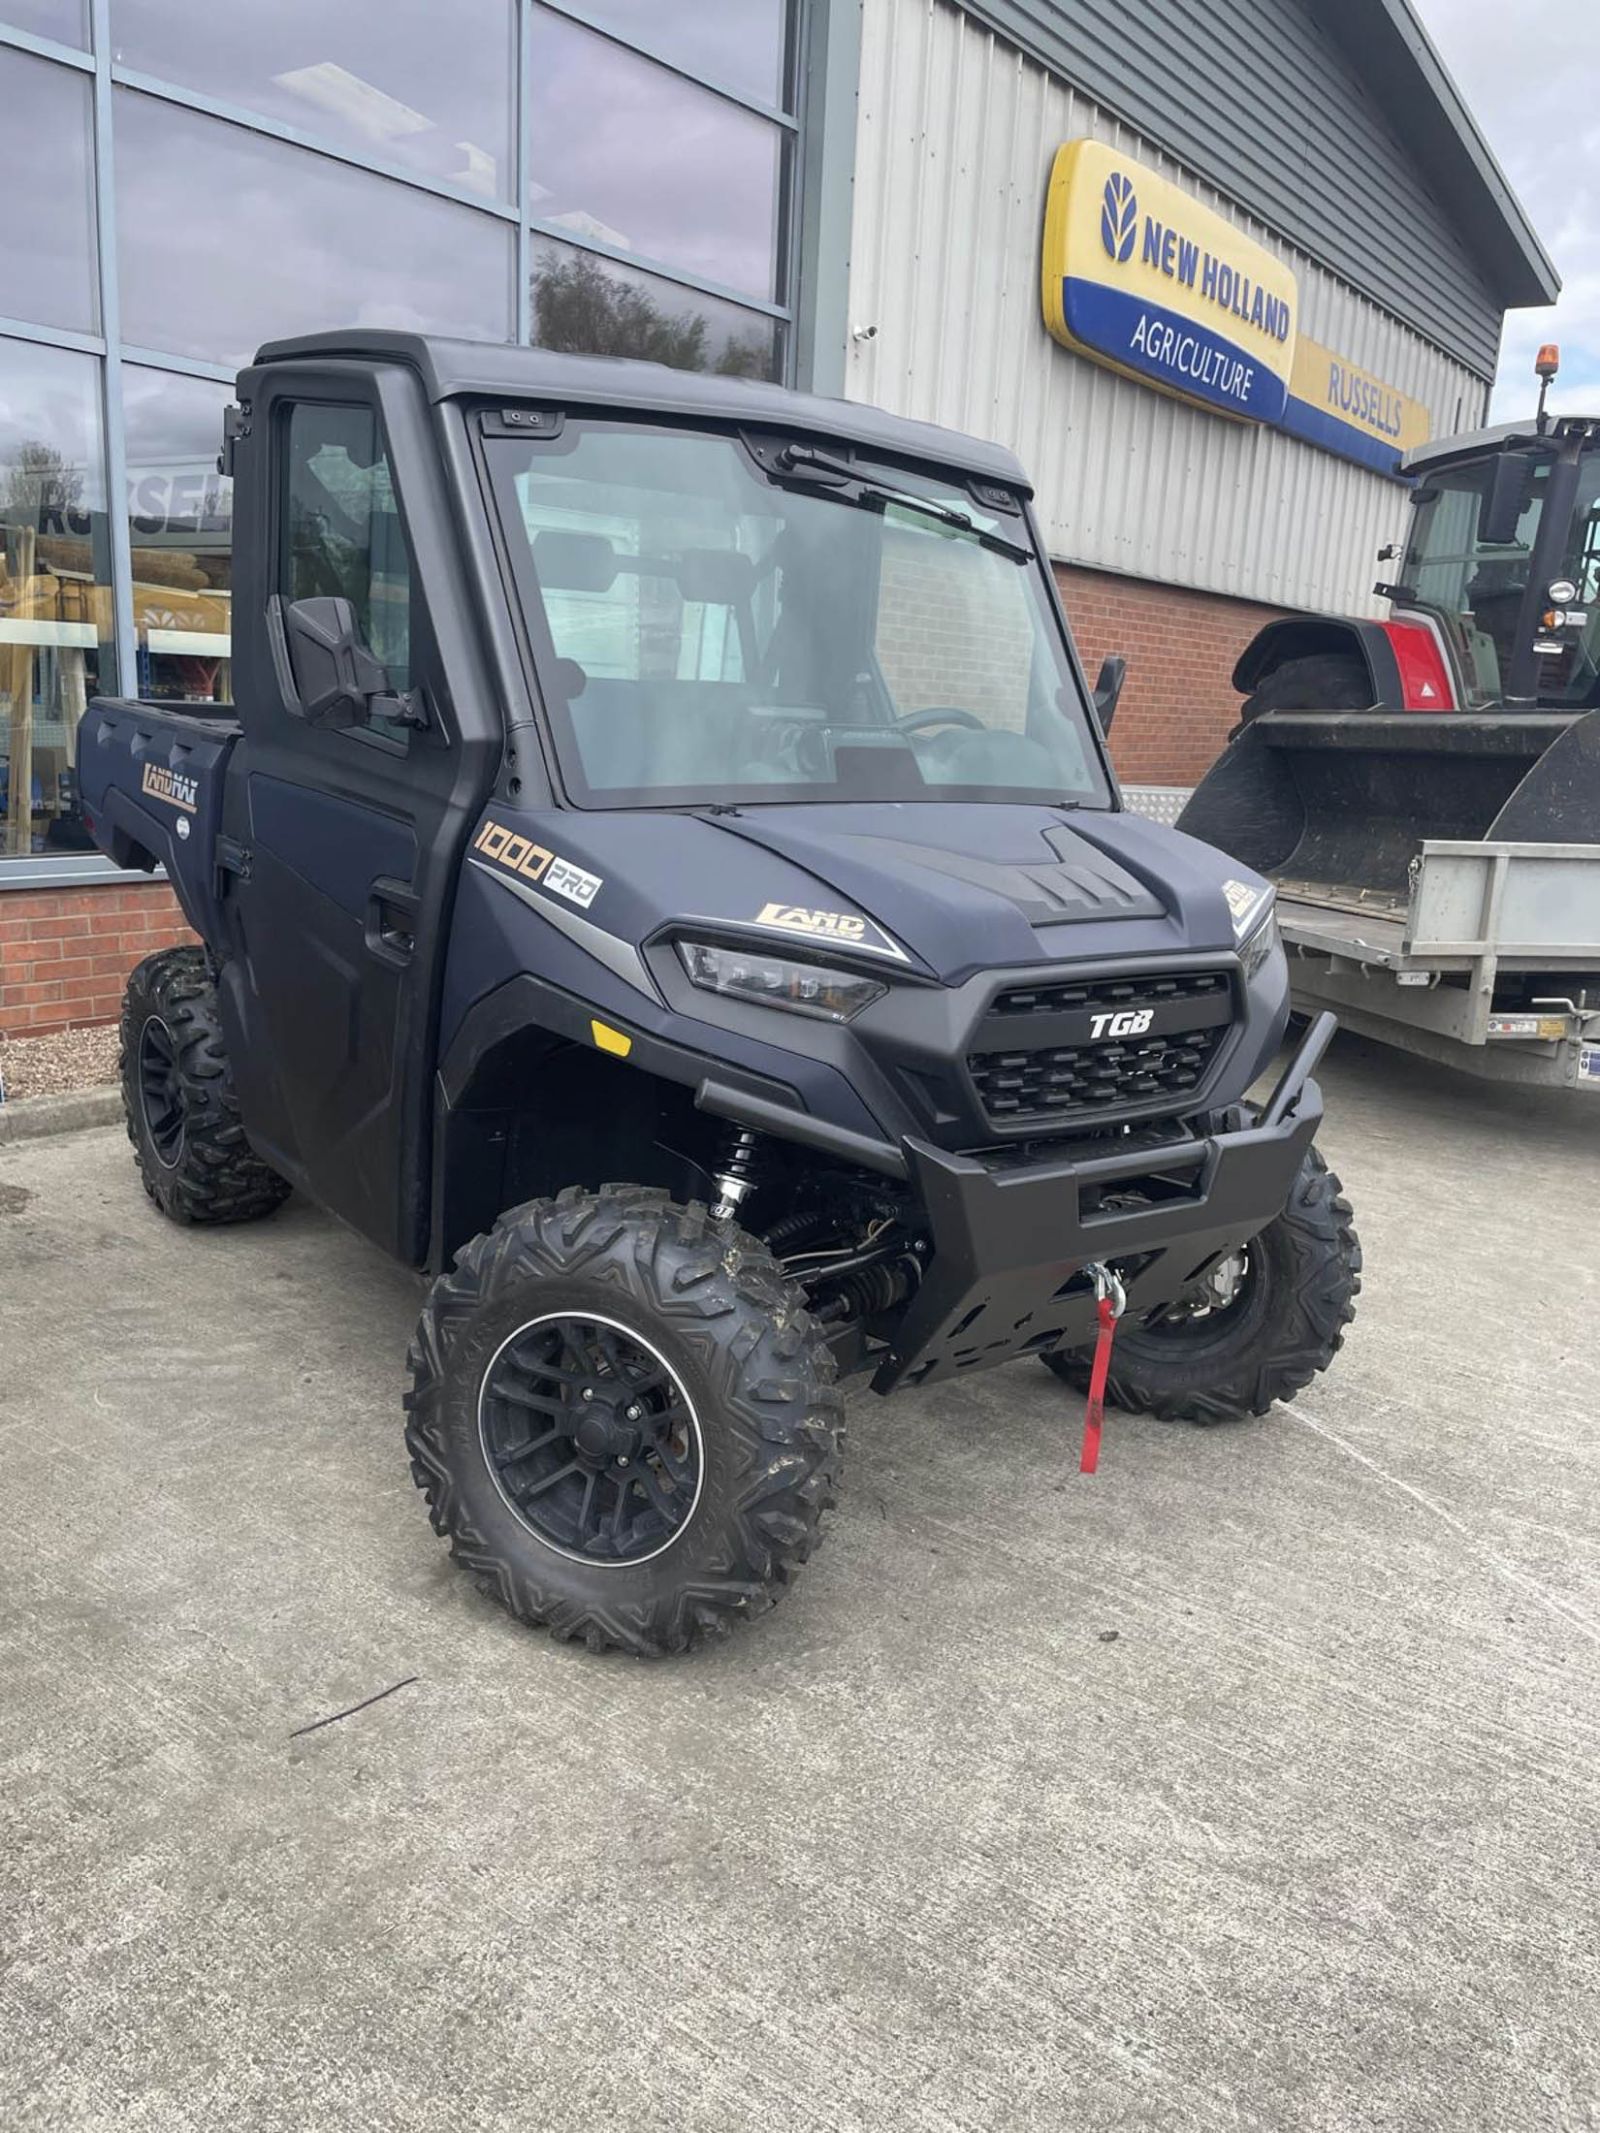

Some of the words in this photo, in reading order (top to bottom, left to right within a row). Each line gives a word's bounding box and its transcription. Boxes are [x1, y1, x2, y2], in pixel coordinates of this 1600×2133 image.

[1142, 215, 1200, 288] NEW
[1202, 252, 1290, 343] HOLLAND
[1130, 314, 1254, 402] AGRICULTURE
[1328, 362, 1402, 438] RUSSELLS
[142, 762, 199, 815] LANDMAX
[474, 820, 555, 881] 1000
[547, 862, 599, 902] PRO
[756, 902, 866, 940] LAND
[1090, 1009, 1155, 1040] TGB
